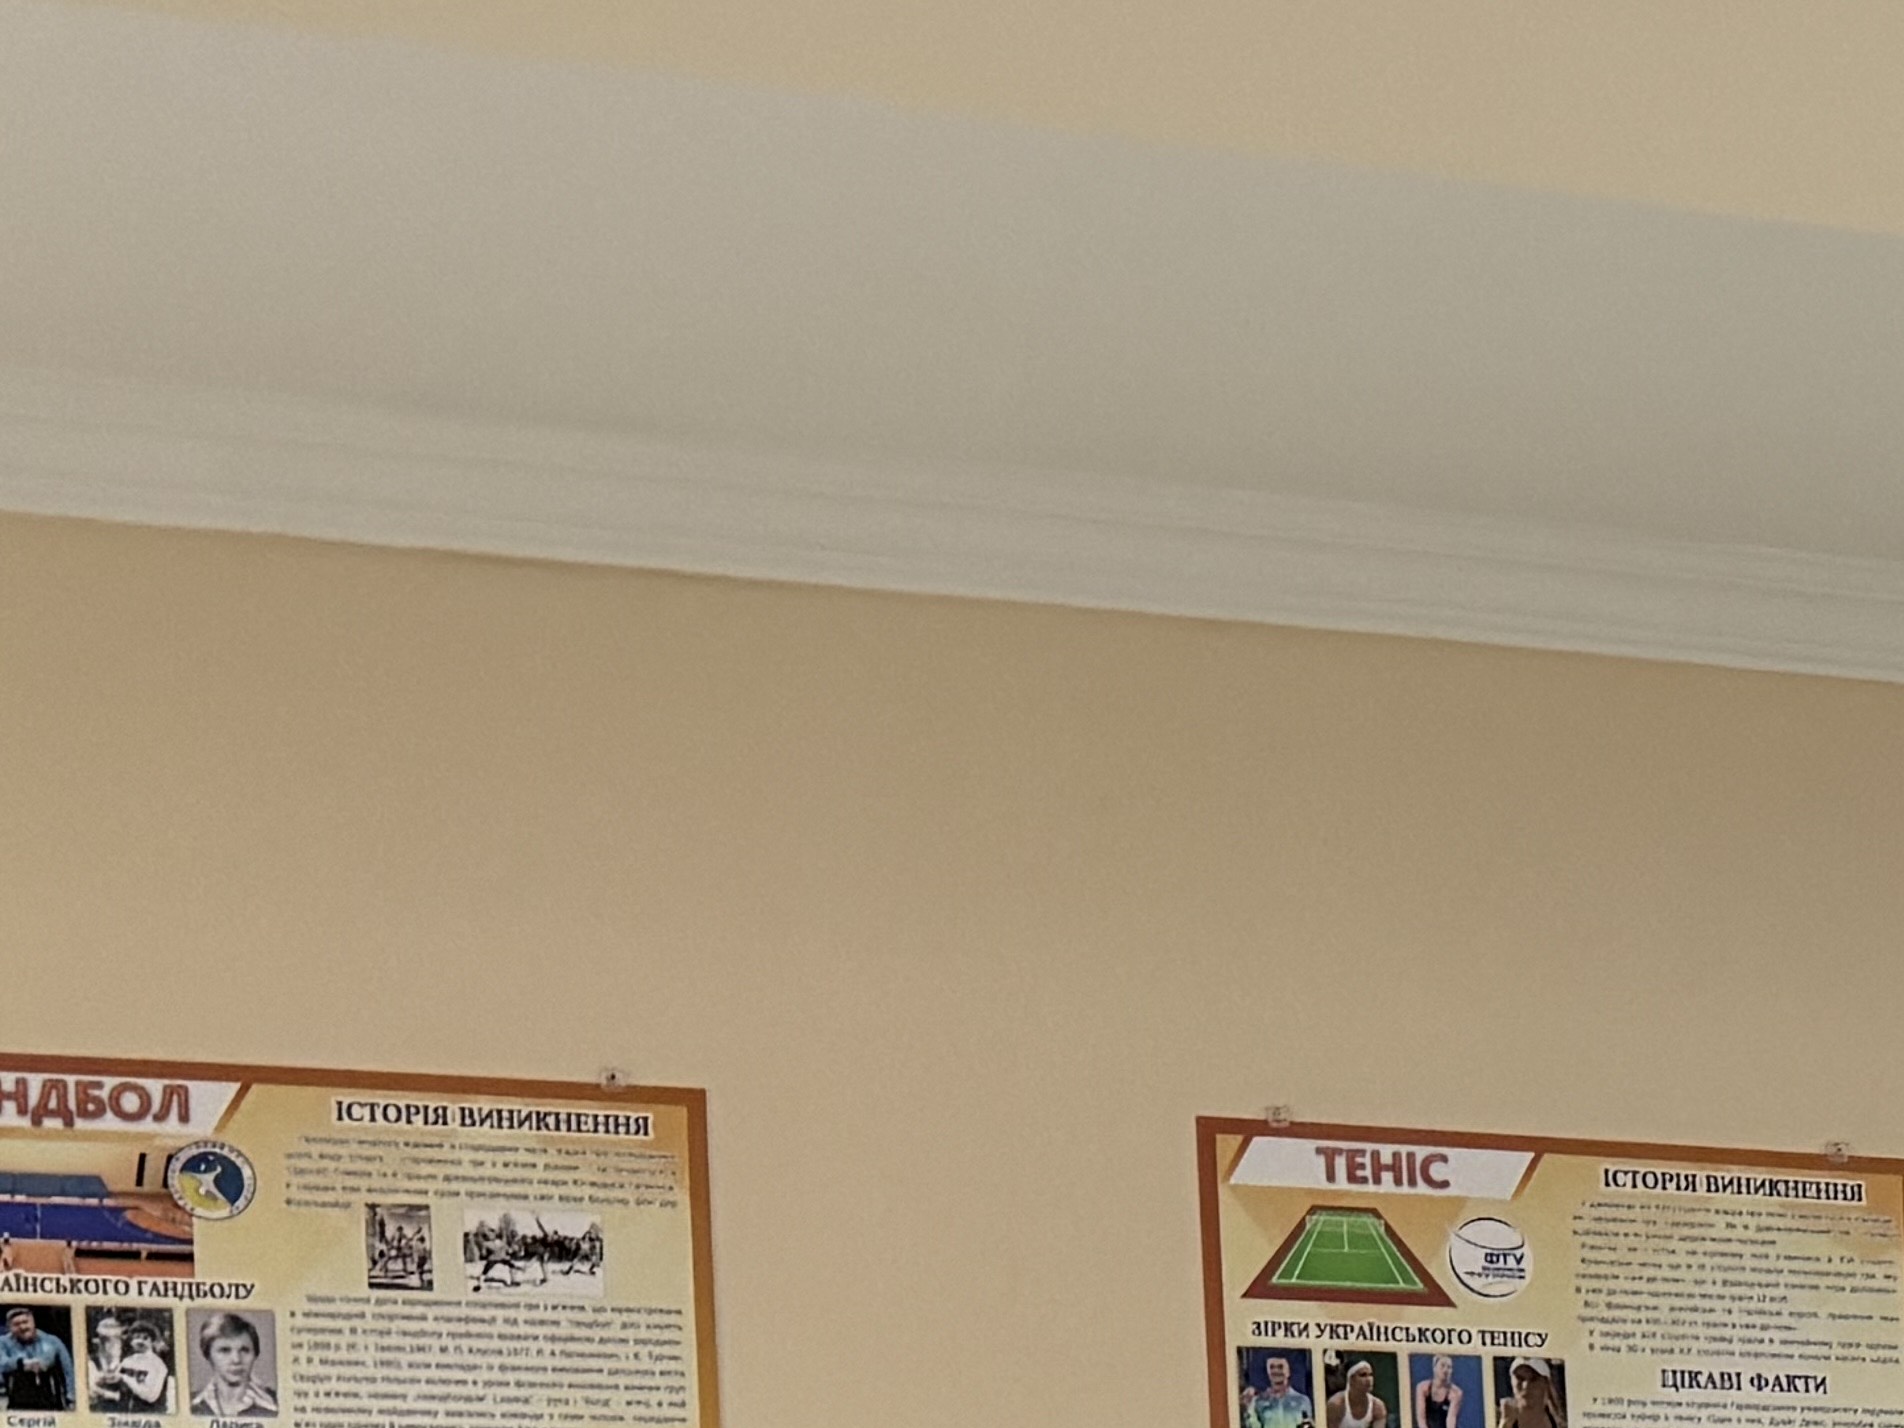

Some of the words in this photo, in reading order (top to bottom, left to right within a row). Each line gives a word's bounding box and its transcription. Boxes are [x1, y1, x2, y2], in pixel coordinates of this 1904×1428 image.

[335, 1099, 450, 1127] ІСТОРІЯ
[458, 1105, 651, 1137] ВИНИКНЕННЯ
[1315, 1146, 1451, 1189] ТЕНІС
[1604, 1168, 1698, 1192] ІСТОРІЯ
[1705, 1174, 1864, 1202] ВИНИКНЕННЯ
[136, 1280, 256, 1301] ГАНДБОЛУ
[1251, 1320, 1310, 1339] ЗІРКИ
[1314, 1320, 1472, 1346] УКРАЇНСЬКОГО
[1477, 1329, 1549, 1348] ТЕНІСУ
[1661, 1369, 1742, 1393] ЦІКАВІ
[1749, 1373, 1828, 1395] ФАКТИ
